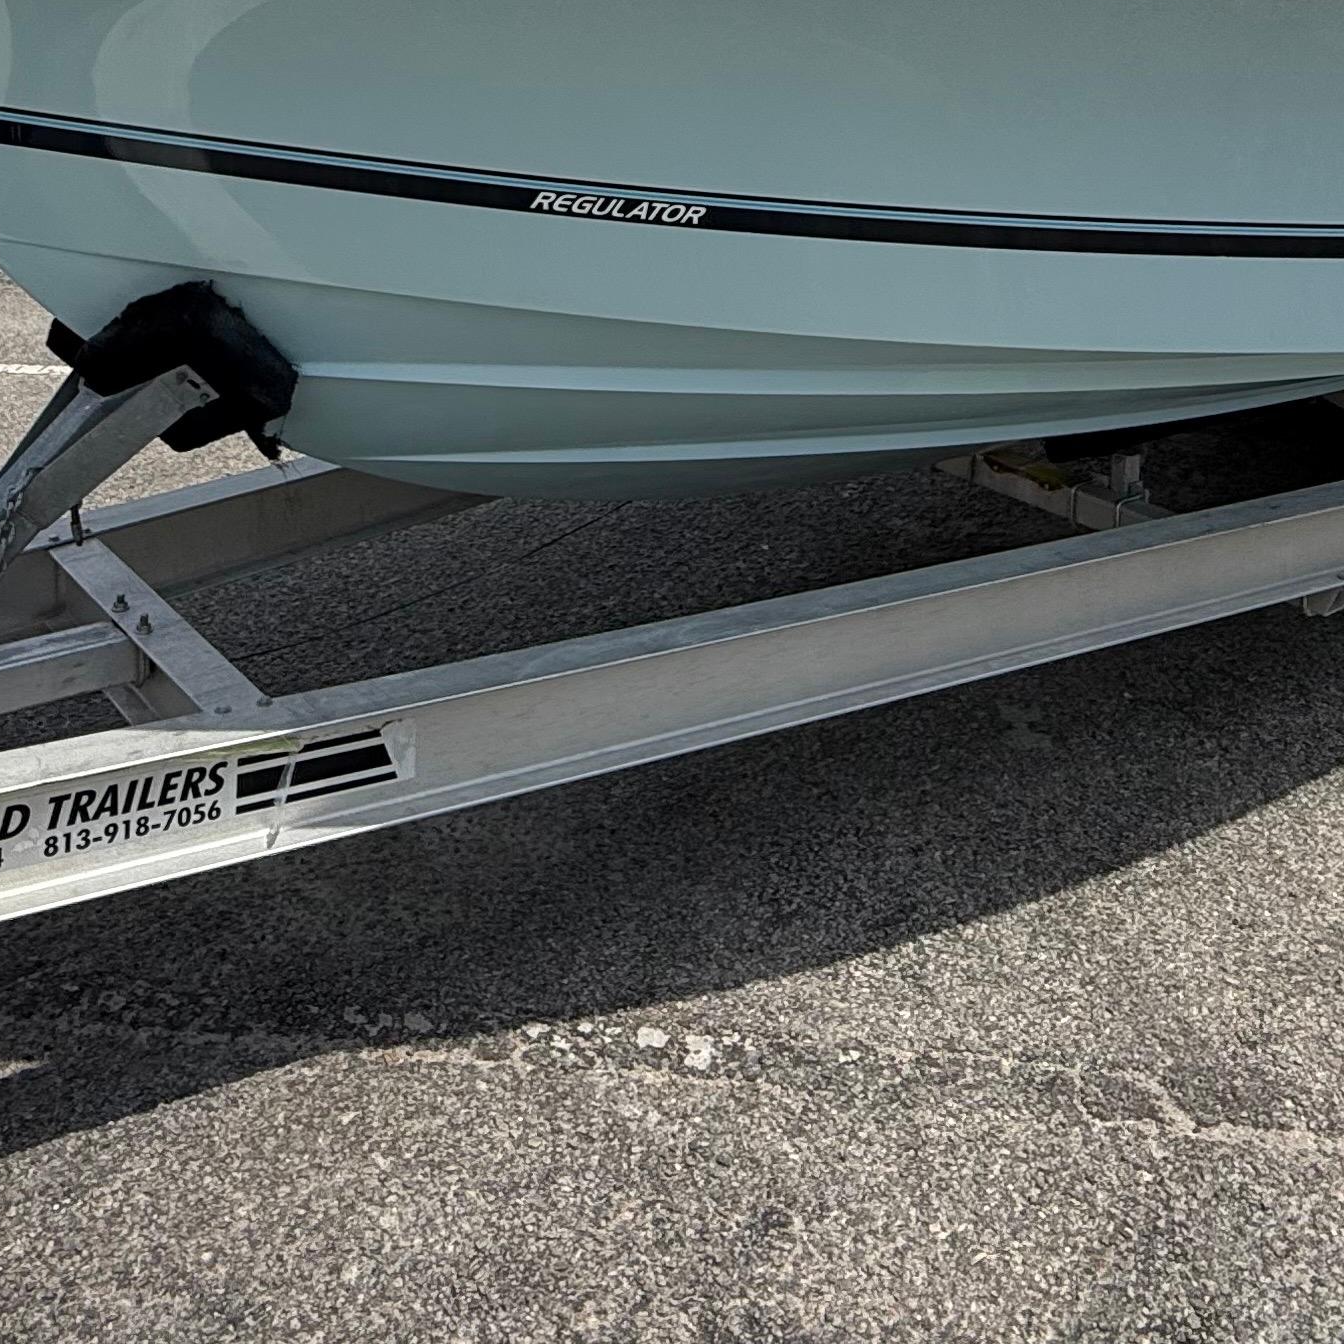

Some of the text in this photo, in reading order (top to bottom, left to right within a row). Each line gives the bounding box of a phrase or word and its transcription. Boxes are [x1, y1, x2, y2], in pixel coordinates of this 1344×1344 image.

[529, 192, 707, 225] REGULATOR
[47, 761, 229, 830] TRAILERS
[44, 800, 222, 857] 813-918-7056
